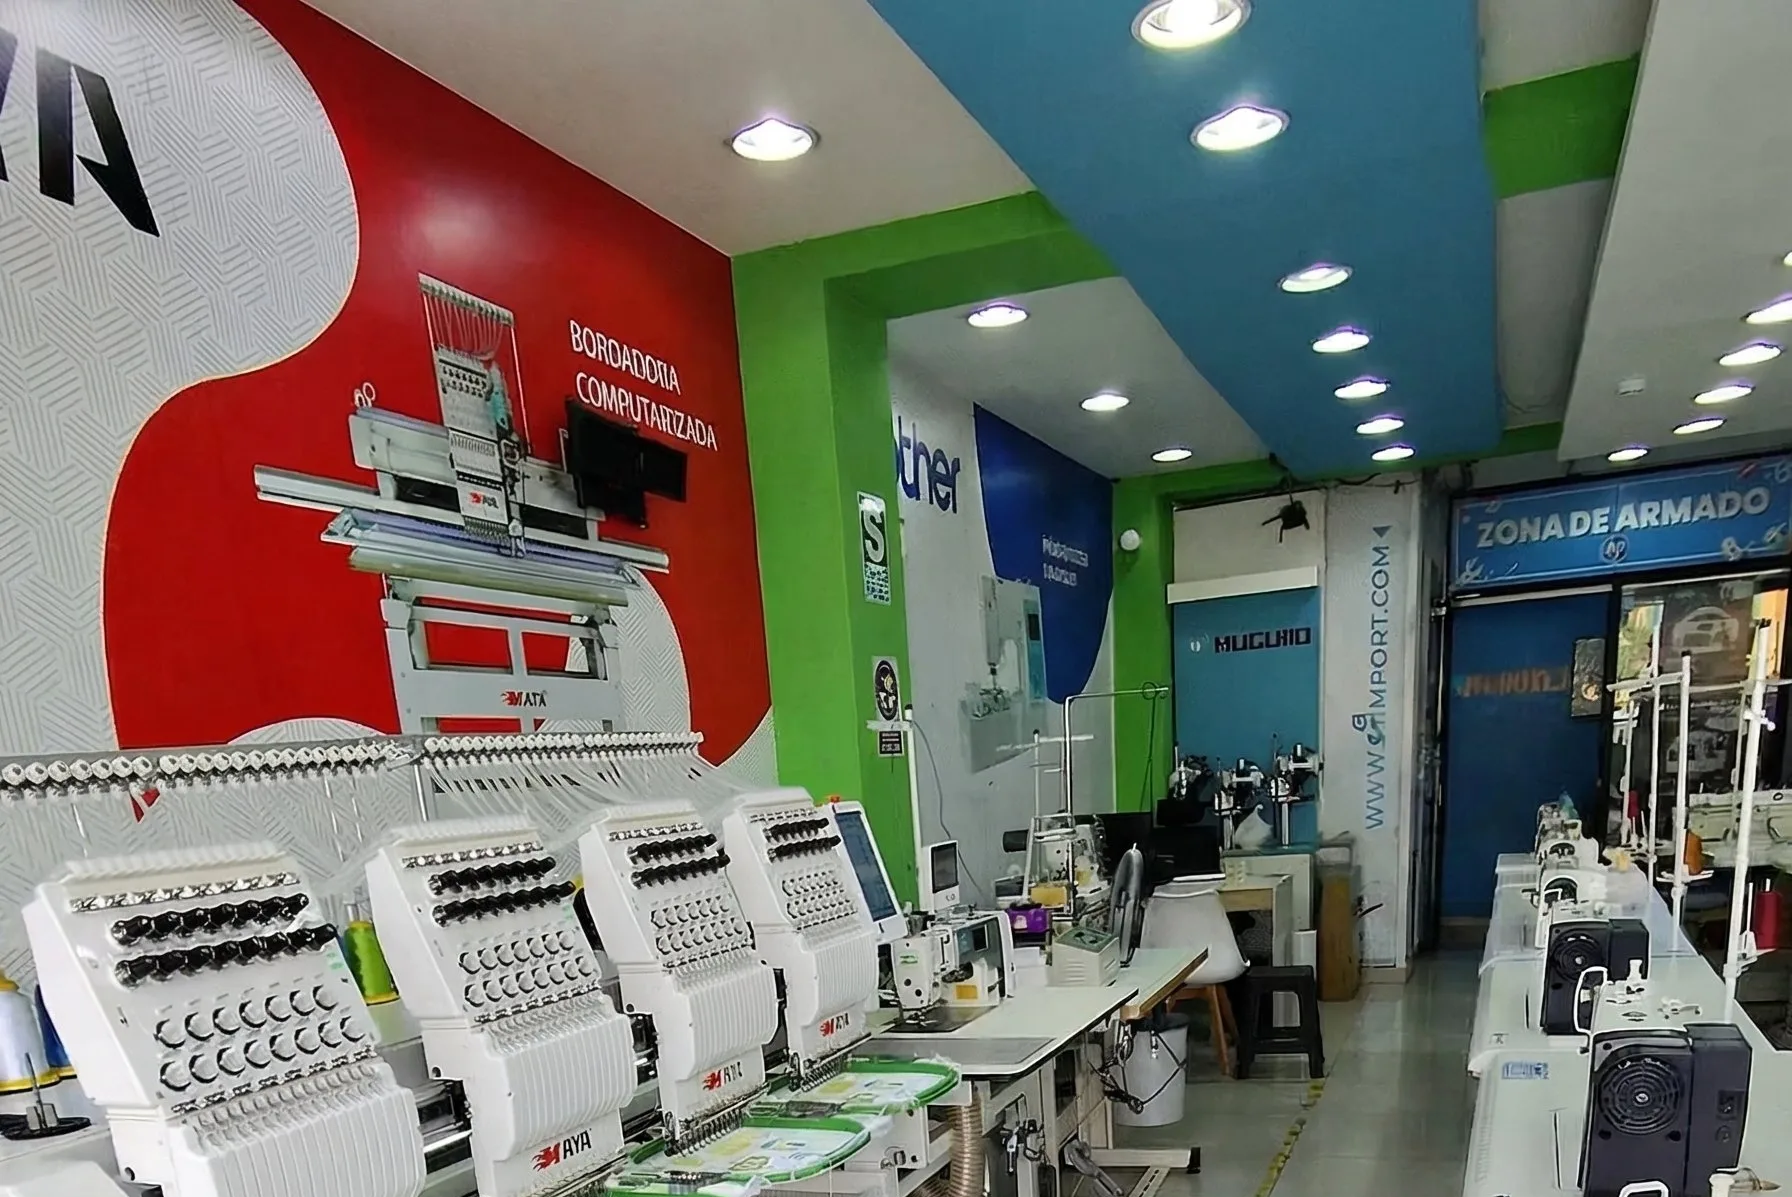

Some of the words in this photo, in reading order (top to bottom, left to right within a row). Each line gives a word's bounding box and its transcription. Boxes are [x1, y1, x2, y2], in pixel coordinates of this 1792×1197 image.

[892, 415, 960, 515] ther
[1477, 517, 1562, 548] ZONA
[1568, 507, 1611, 537] DE
[1612, 486, 1771, 533] ARMADO
